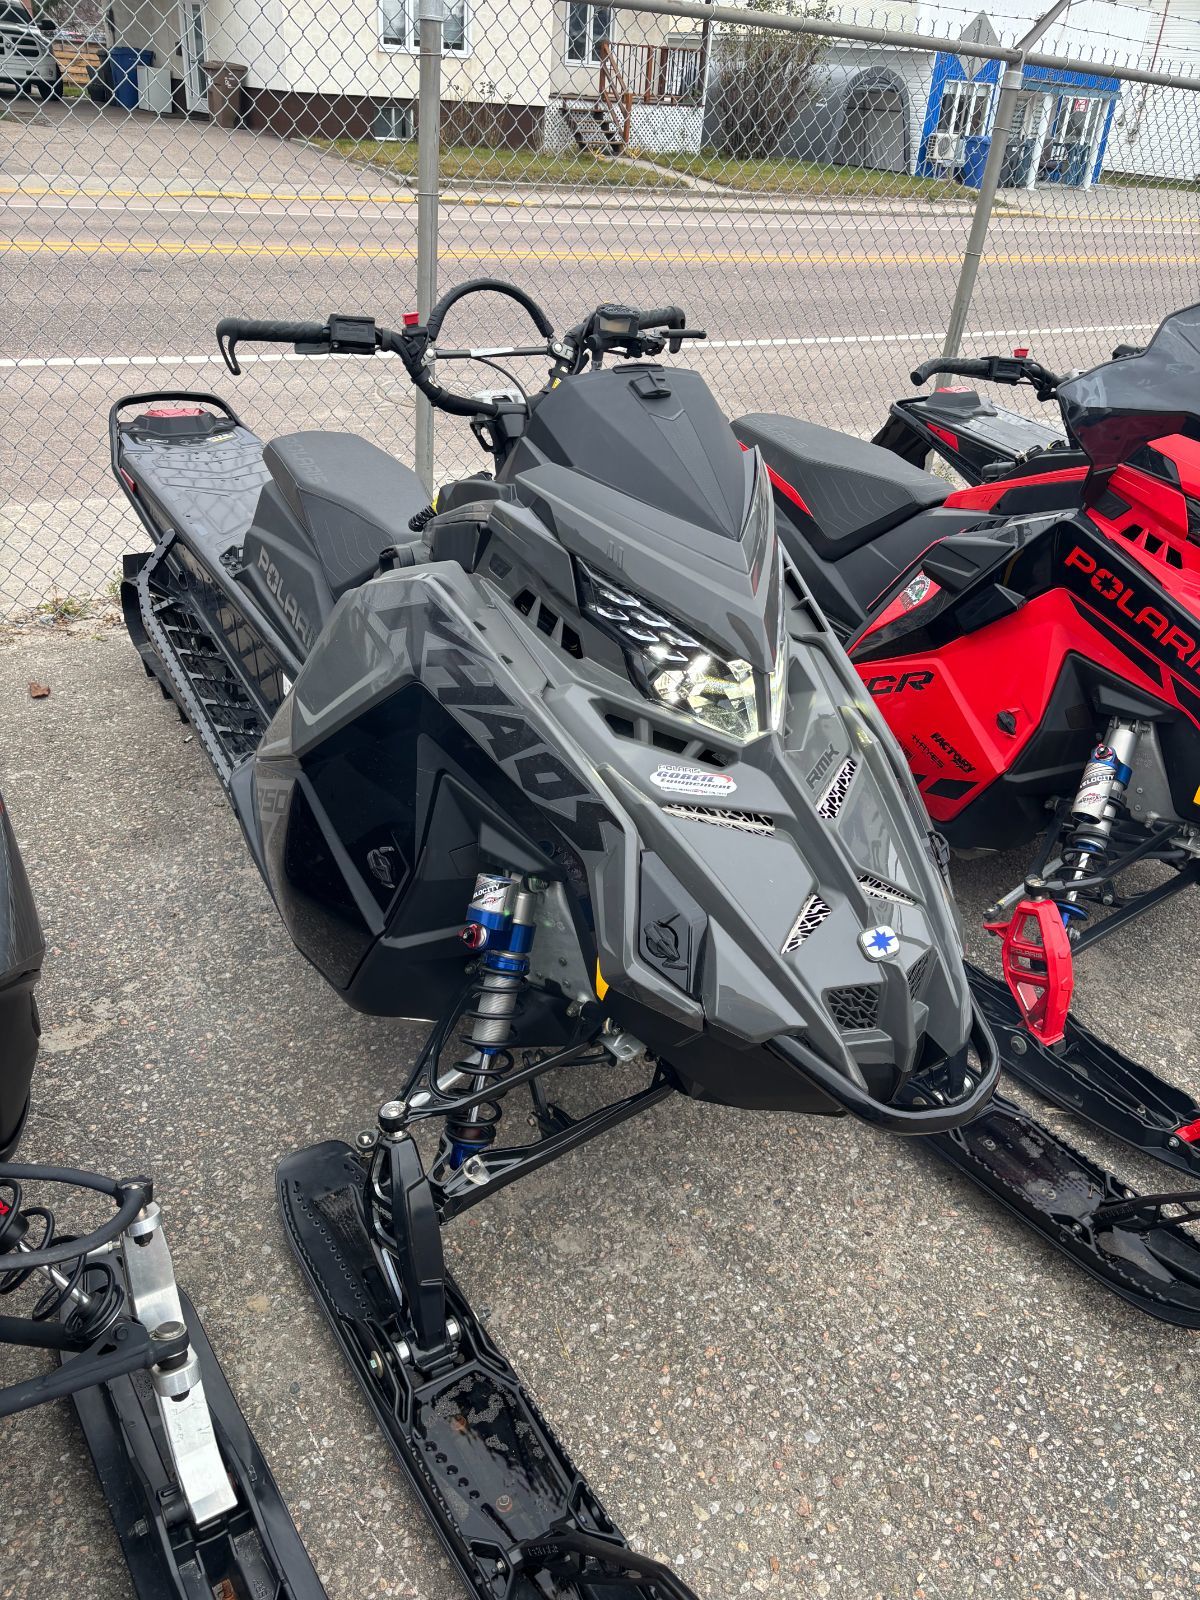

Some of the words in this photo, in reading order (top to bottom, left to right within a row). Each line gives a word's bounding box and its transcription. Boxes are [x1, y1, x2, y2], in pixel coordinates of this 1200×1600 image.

[257, 545, 318, 651] POLARI
[1064, 546, 1200, 678] POLARI
[863, 670, 935, 695] CR
[805, 743, 840, 790] RMK
[930, 732, 976, 773] FACTORY
